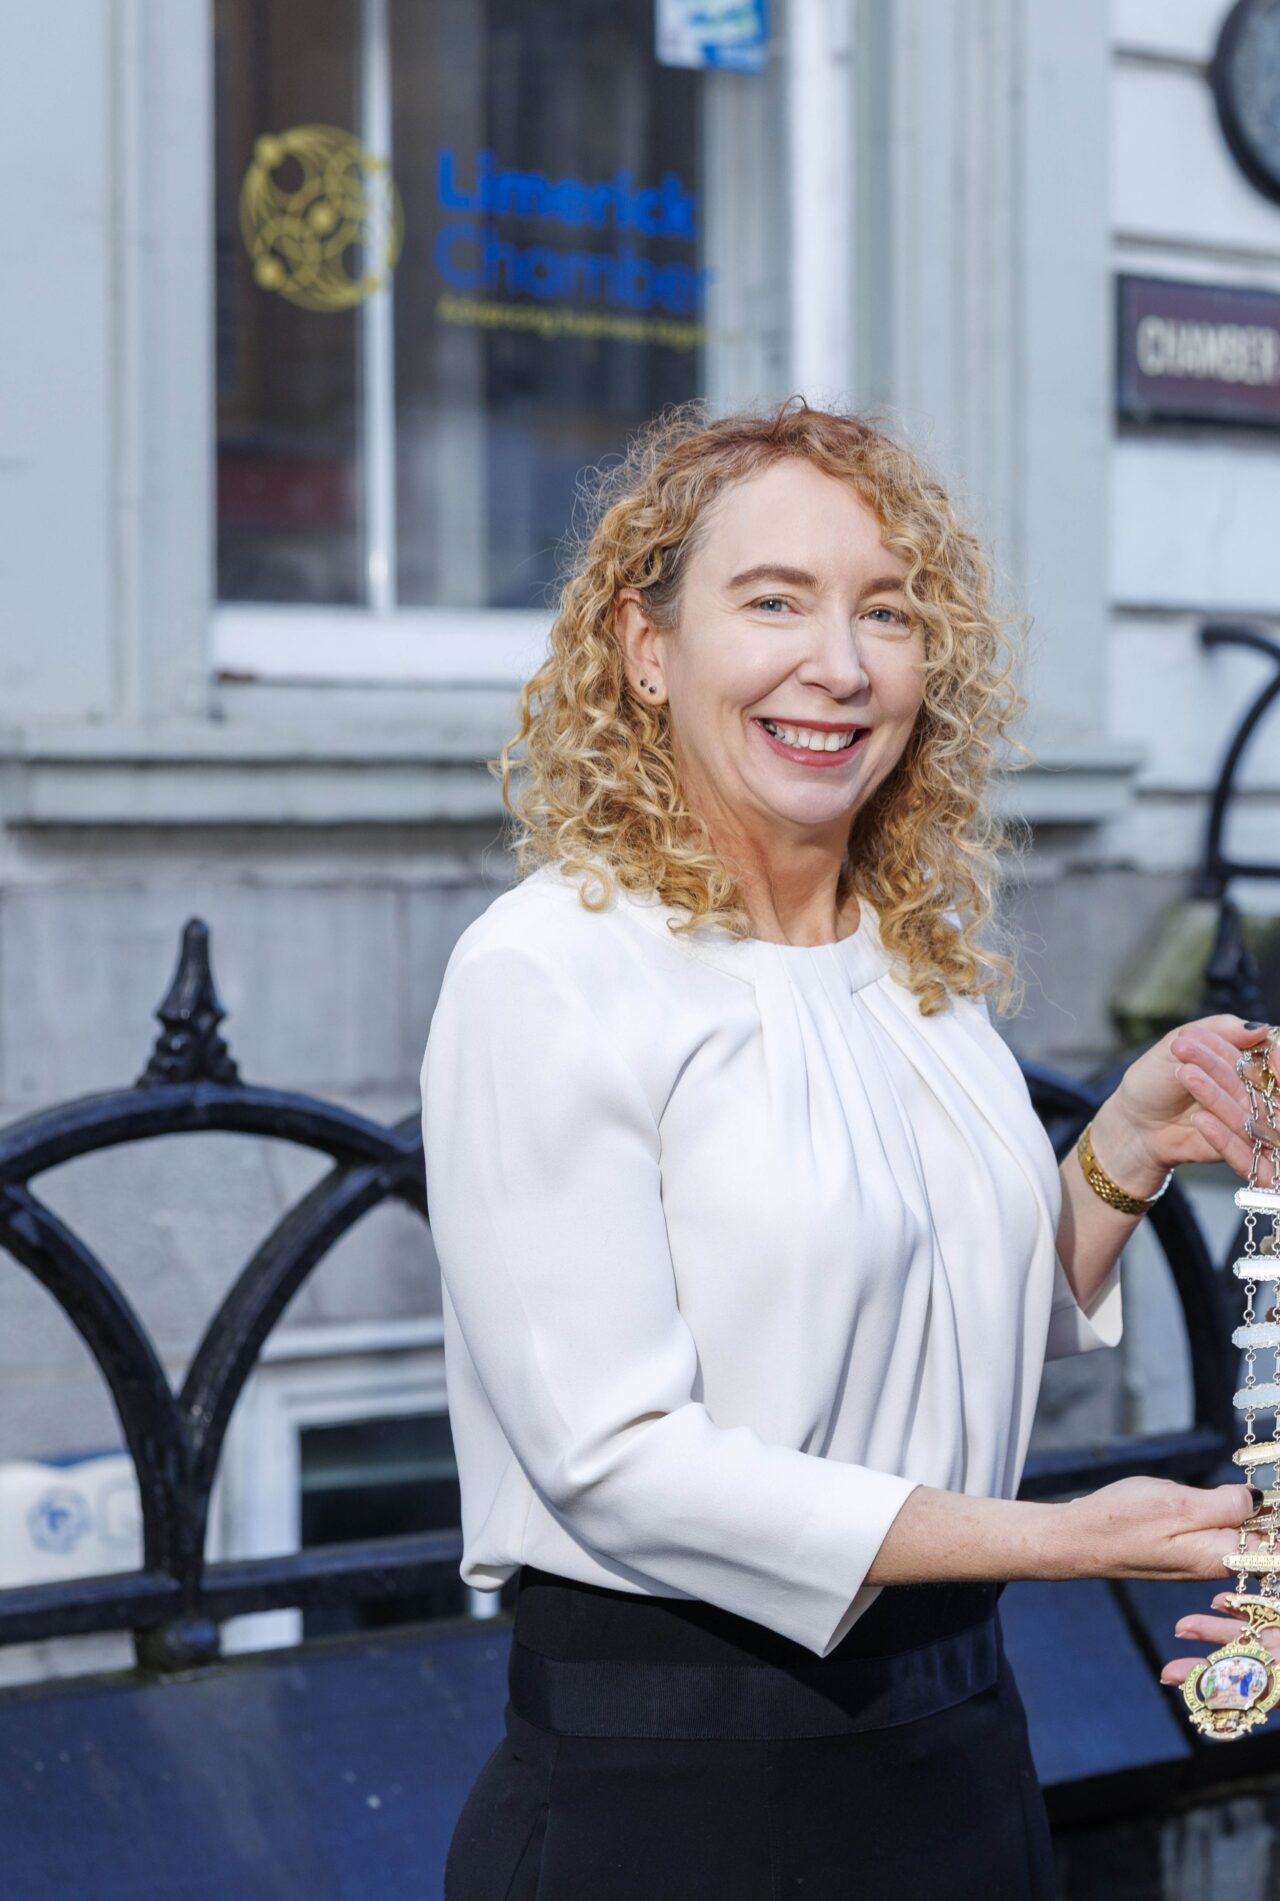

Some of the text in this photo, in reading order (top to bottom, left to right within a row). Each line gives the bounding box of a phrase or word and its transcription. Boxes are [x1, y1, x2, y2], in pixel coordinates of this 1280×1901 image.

[436, 147, 701, 240] Limerick
[434, 221, 714, 314] Chamber
[1136, 315, 1280, 386] CHAMBER
